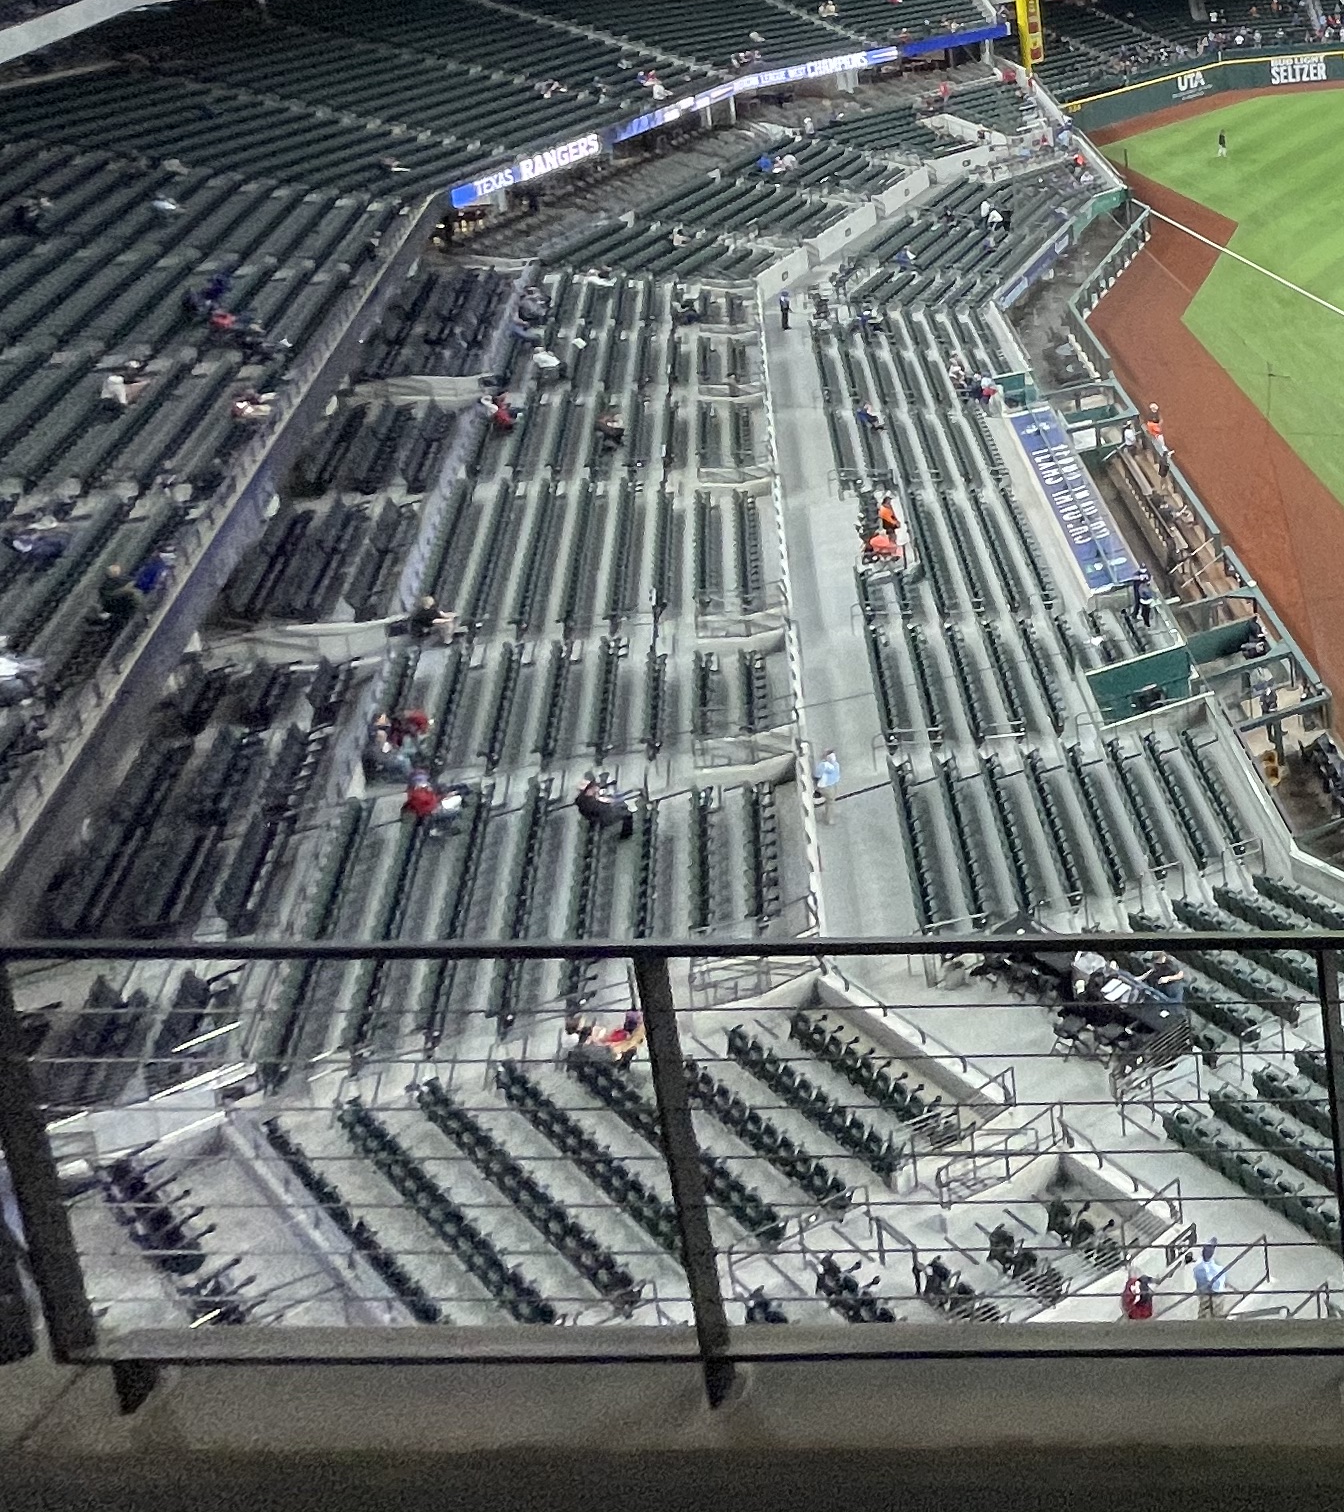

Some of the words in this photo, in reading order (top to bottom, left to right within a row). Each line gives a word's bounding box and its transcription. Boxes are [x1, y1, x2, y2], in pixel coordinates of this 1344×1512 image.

[806, 51, 868, 78] CHAMPIONS
[1271, 62, 1328, 85] SELTZER
[1177, 70, 1206, 92] UTA
[473, 167, 515, 196] TEXAS
[518, 132, 600, 182] RANGERS
